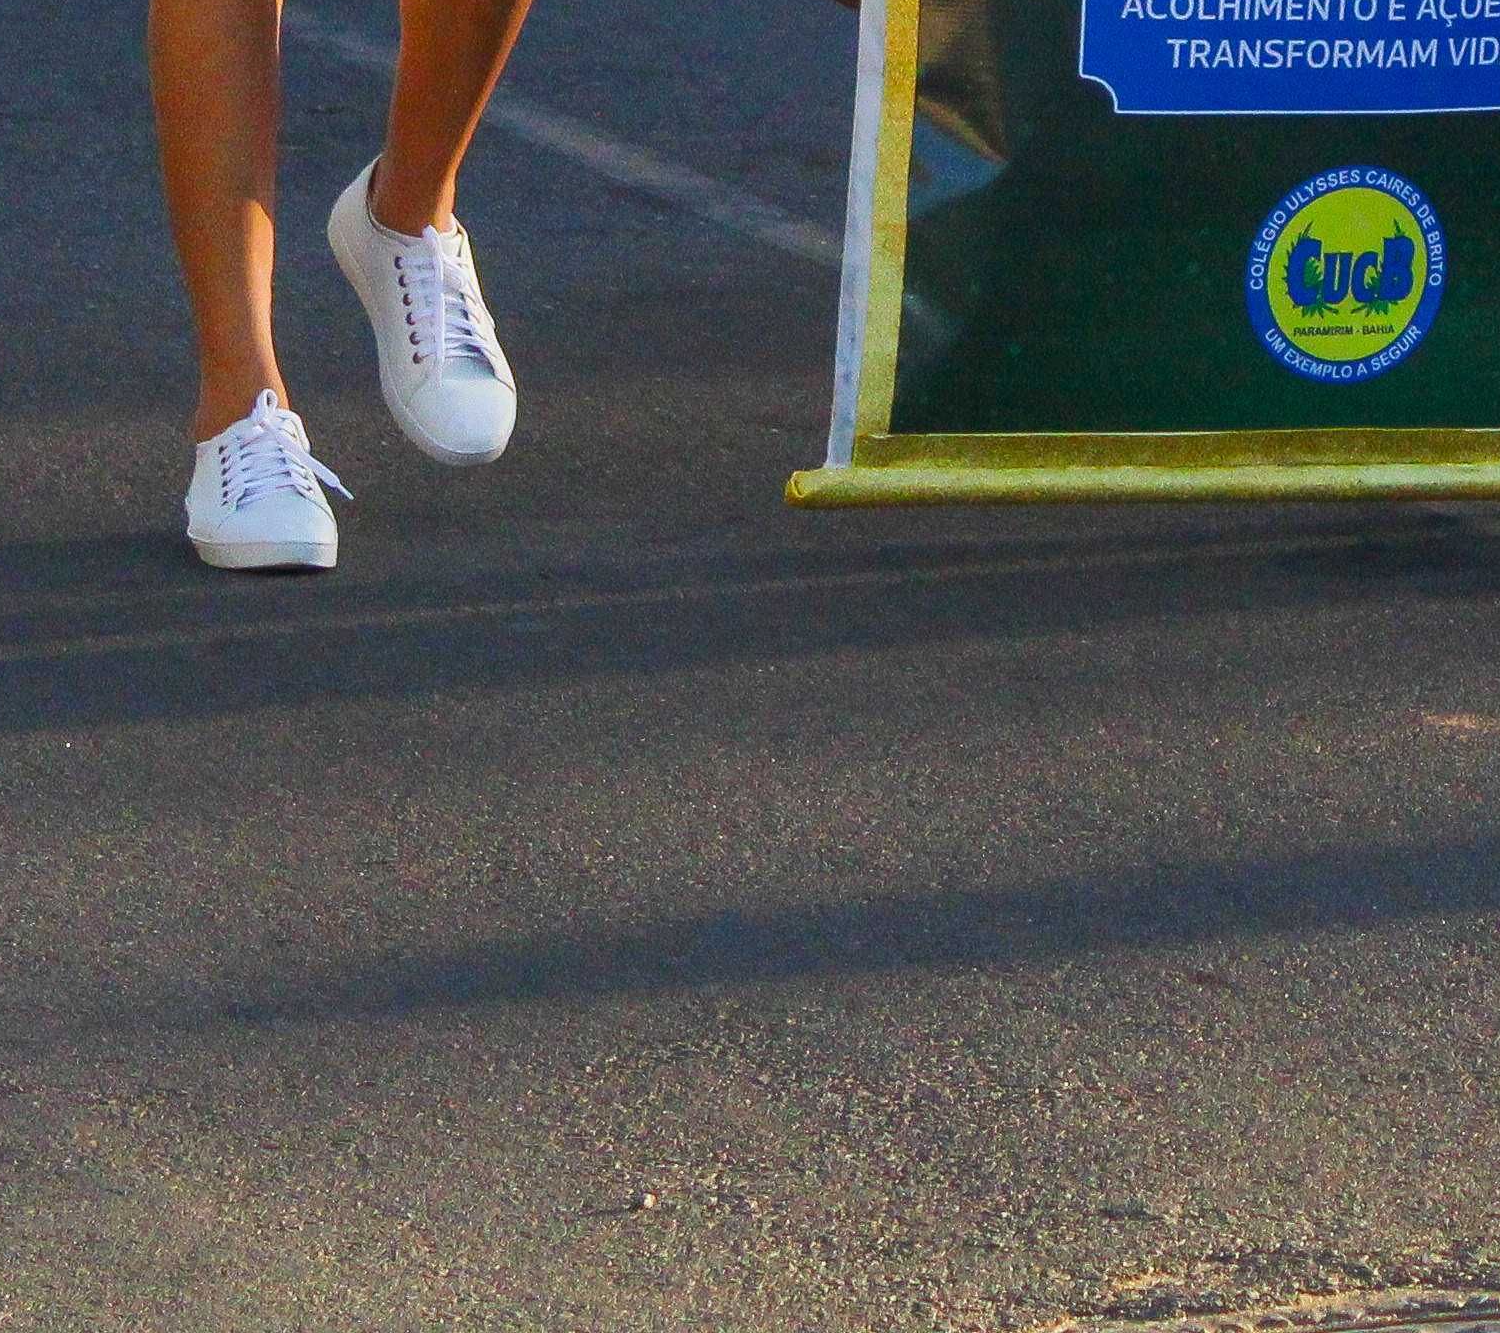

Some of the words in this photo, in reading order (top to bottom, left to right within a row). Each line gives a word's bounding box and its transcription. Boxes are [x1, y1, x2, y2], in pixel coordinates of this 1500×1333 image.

[1166, 38, 1438, 69] TRANSFORMAM
[1250, 210, 1286, 290] COLÉGIO
[1285, 169, 1361, 213] ULYSSES
[1365, 170, 1421, 207] CAIRES
[1416, 204, 1436, 229] DE
[1426, 230, 1444, 287] BRITO
[1264, 328, 1287, 354] UM
[1284, 348, 1353, 379] EXEMPLO
[1356, 364, 1368, 376] A
[1371, 324, 1422, 371] SEGUIR
[1293, 324, 1353, 337] PARAMIRIM
[1362, 323, 1395, 335] BAHIA
